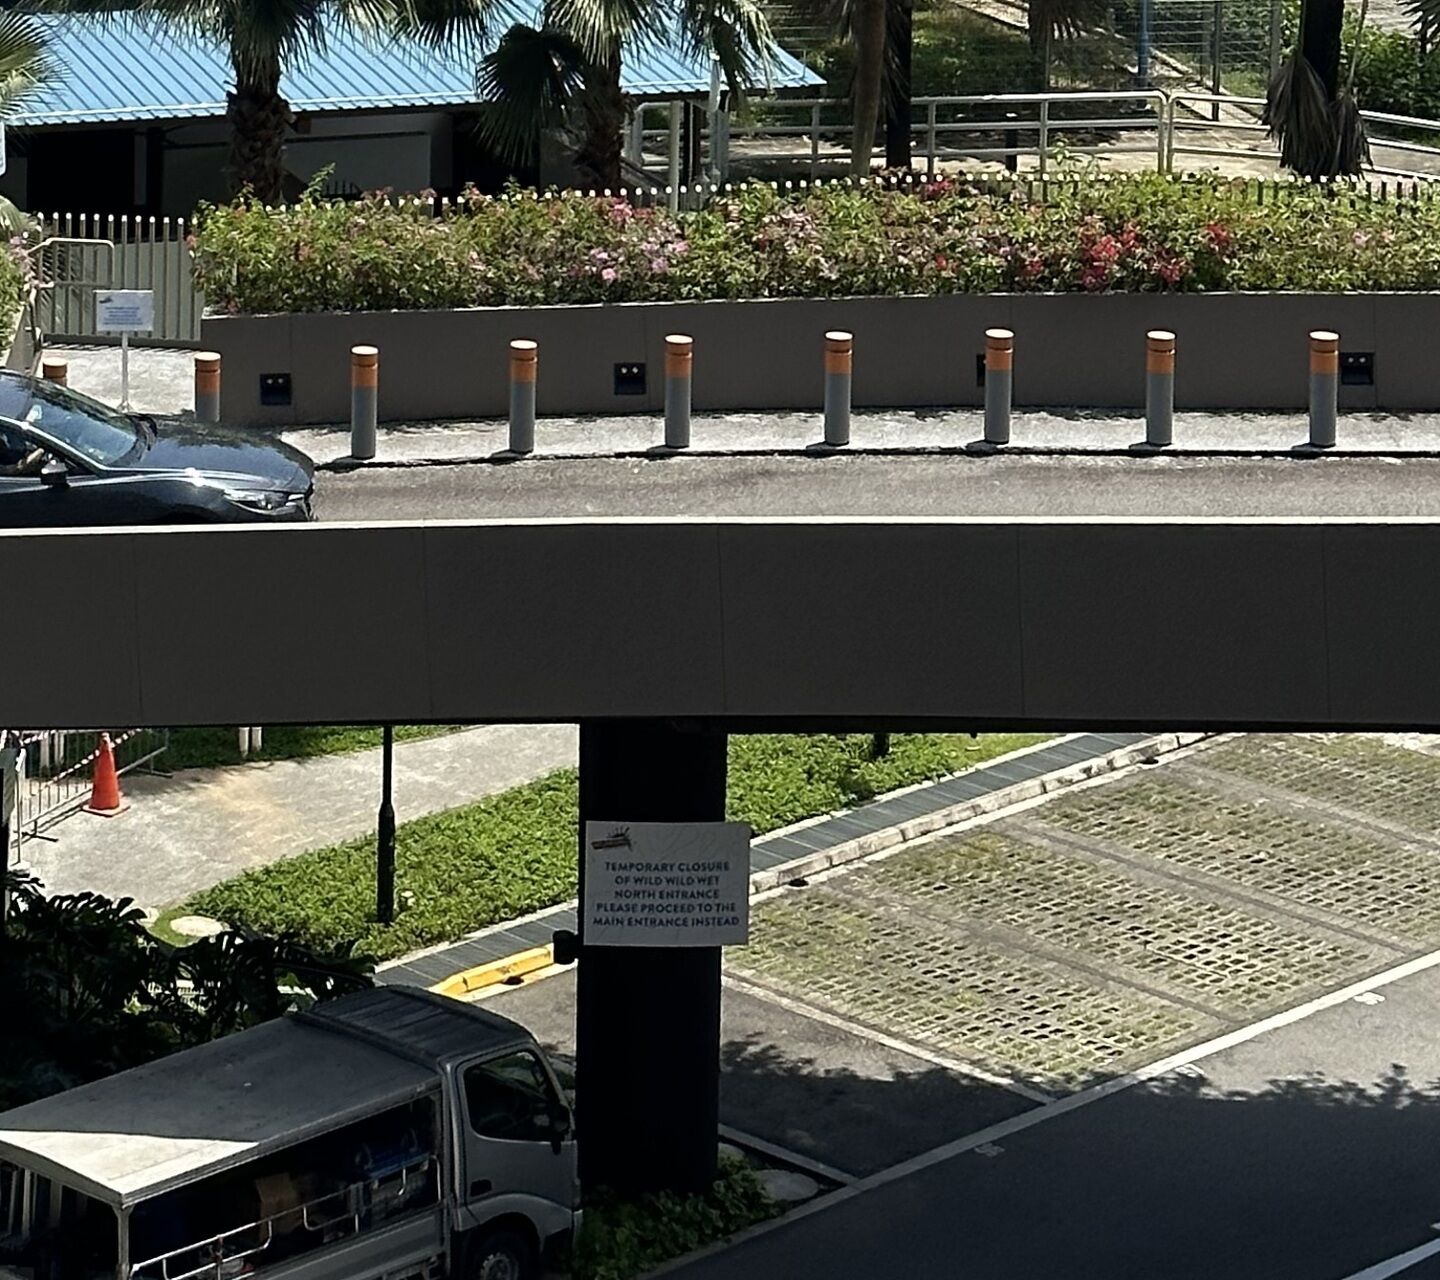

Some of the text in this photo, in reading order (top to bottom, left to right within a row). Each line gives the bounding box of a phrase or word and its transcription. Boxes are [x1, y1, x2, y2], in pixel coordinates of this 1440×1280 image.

[604, 861, 730, 872] TEMPORARY CLOSURE
[614, 875, 719, 886] OF WILD WILD WET
[614, 889, 720, 899] NORTH ENTRANCE
[596, 902, 736, 913] PLEASE PROCEED TO THE
[593, 917, 740, 927] MAIN ENTRANCE INSTEAD
